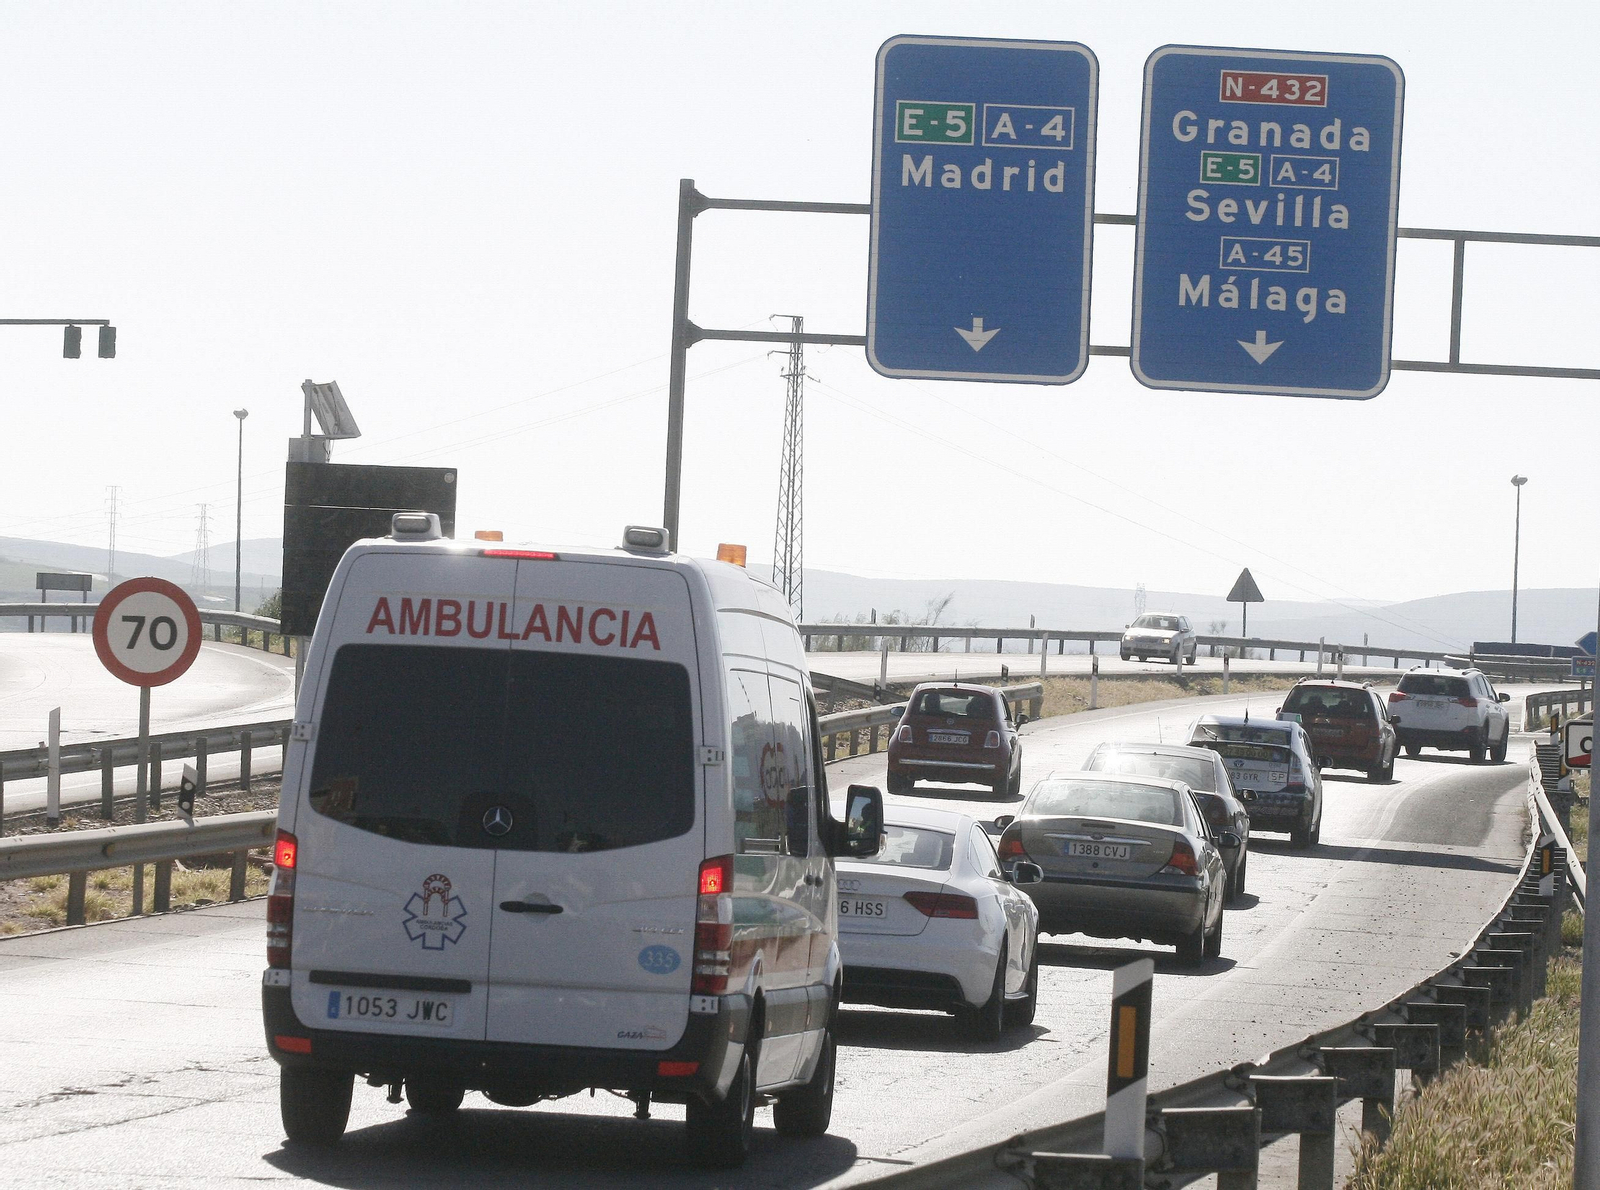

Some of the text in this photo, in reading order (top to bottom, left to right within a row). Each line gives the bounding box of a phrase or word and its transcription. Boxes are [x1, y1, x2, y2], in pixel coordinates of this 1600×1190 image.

[1224, 74, 1323, 102] N-432
[902, 107, 1066, 141] E-5 A-4
[1171, 110, 1371, 153] Granada
[900, 154, 1066, 194] Madrid
[1205, 157, 1333, 185] E-5 A-4
[1185, 188, 1350, 231] Sevilla
[1227, 243, 1304, 268] A-45
[1177, 274, 1347, 324] Málaga
[121, 615, 178, 651] 70
[366, 596, 662, 651] AMBULANCIA
[1271, 773, 1285, 781] SP
[1072, 843, 1127, 858] 1388 CVJ
[855, 901, 883, 916] HSS
[645, 949, 674, 968] 335
[346, 996, 448, 1021] 1053 JWC
